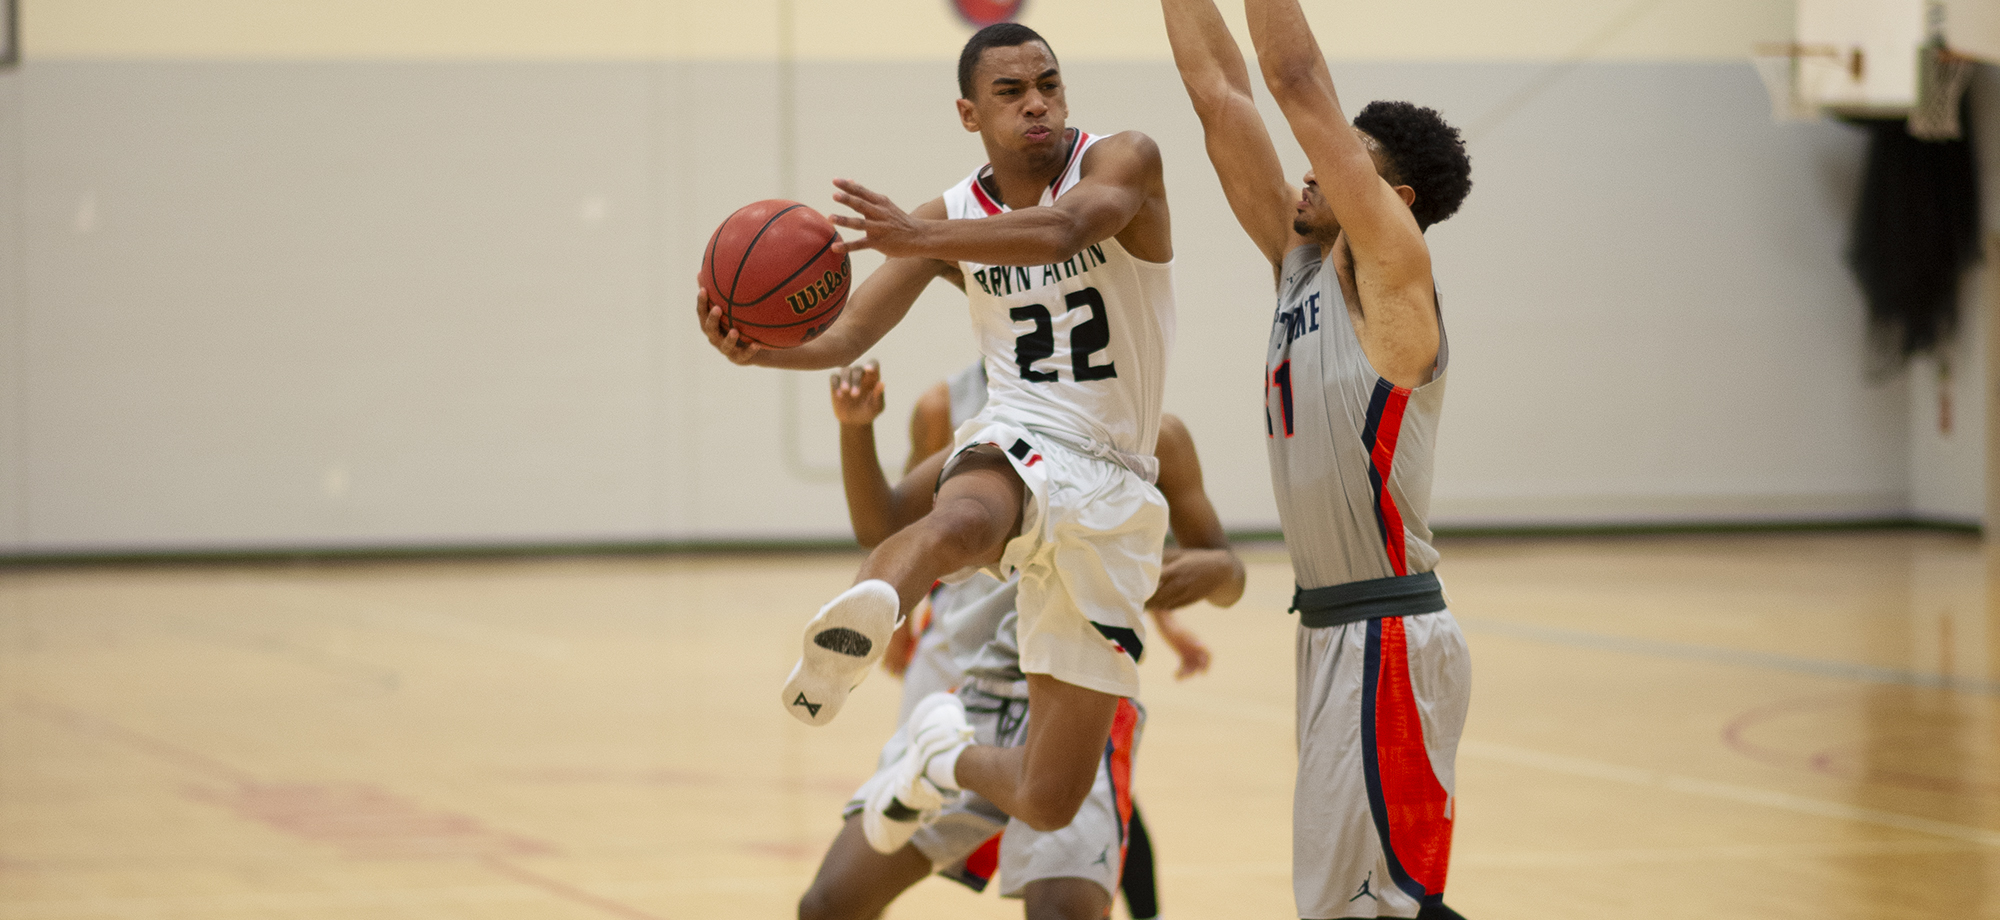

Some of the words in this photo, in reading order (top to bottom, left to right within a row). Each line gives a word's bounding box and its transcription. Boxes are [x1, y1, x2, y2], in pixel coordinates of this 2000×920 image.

[785, 253, 851, 315] Wilso
[973, 265, 1031, 297] BRYN
[1009, 287, 1117, 383] 22
[1265, 359, 1295, 439] 1
